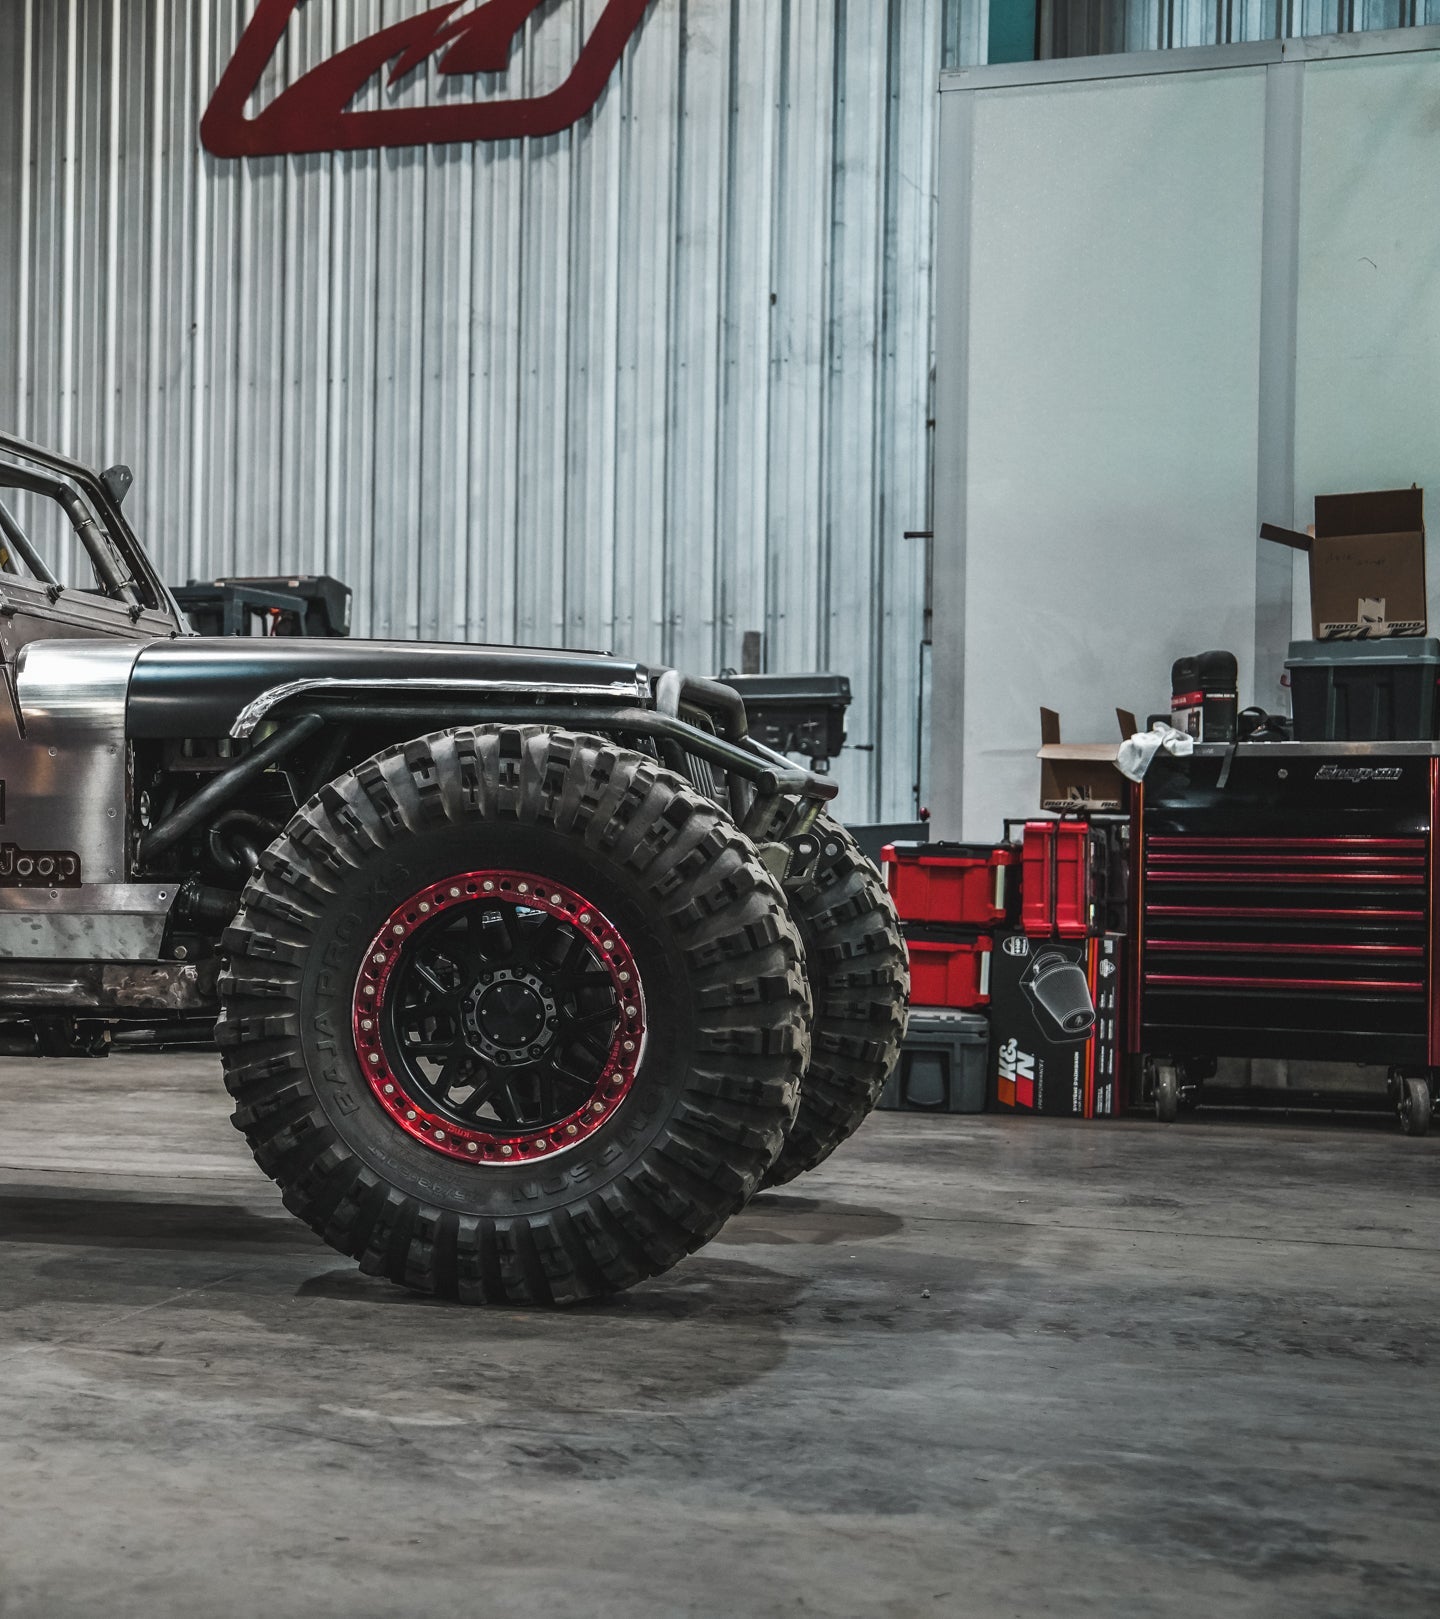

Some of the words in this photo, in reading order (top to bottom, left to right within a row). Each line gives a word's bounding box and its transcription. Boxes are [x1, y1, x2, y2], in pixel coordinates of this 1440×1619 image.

[1324, 623, 1358, 631] MOTO
[1387, 622, 1421, 630] MOTO
[313, 1009, 360, 1116] BAJA
